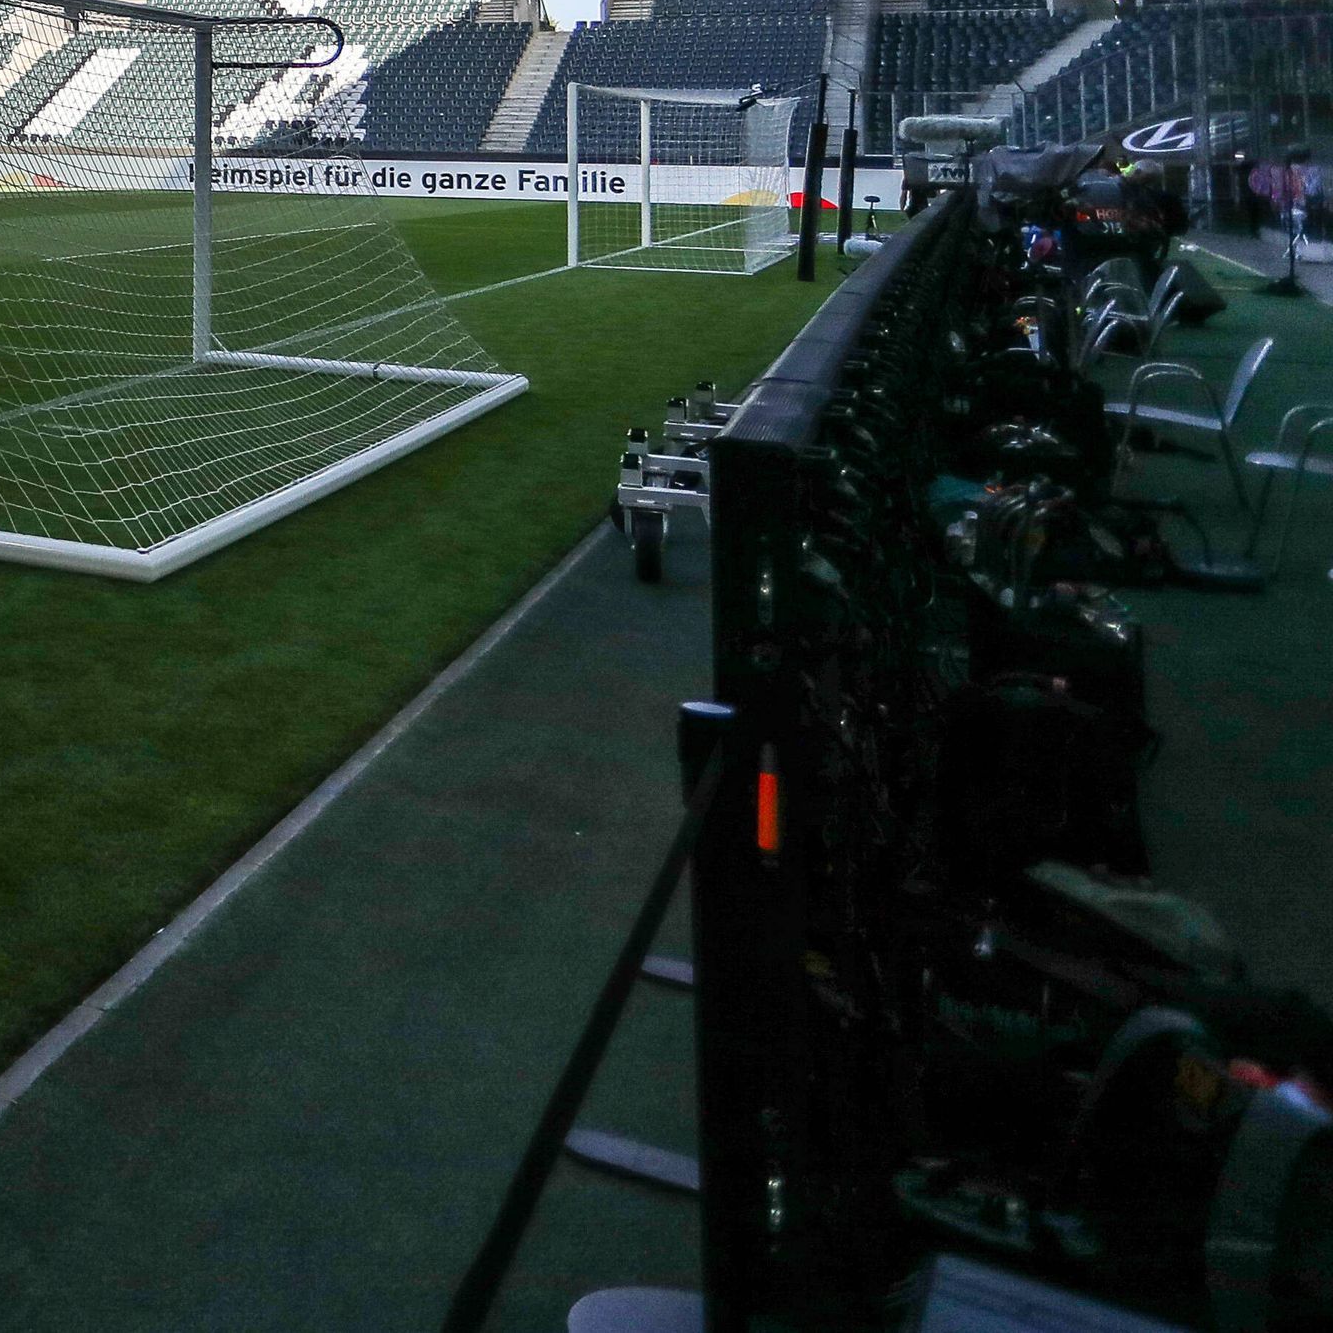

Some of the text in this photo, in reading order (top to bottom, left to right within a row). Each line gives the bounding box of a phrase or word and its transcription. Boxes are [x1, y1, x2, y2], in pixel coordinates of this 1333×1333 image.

[323, 164, 362, 186] für
[372, 166, 411, 189] die
[422, 171, 506, 194] ganze
